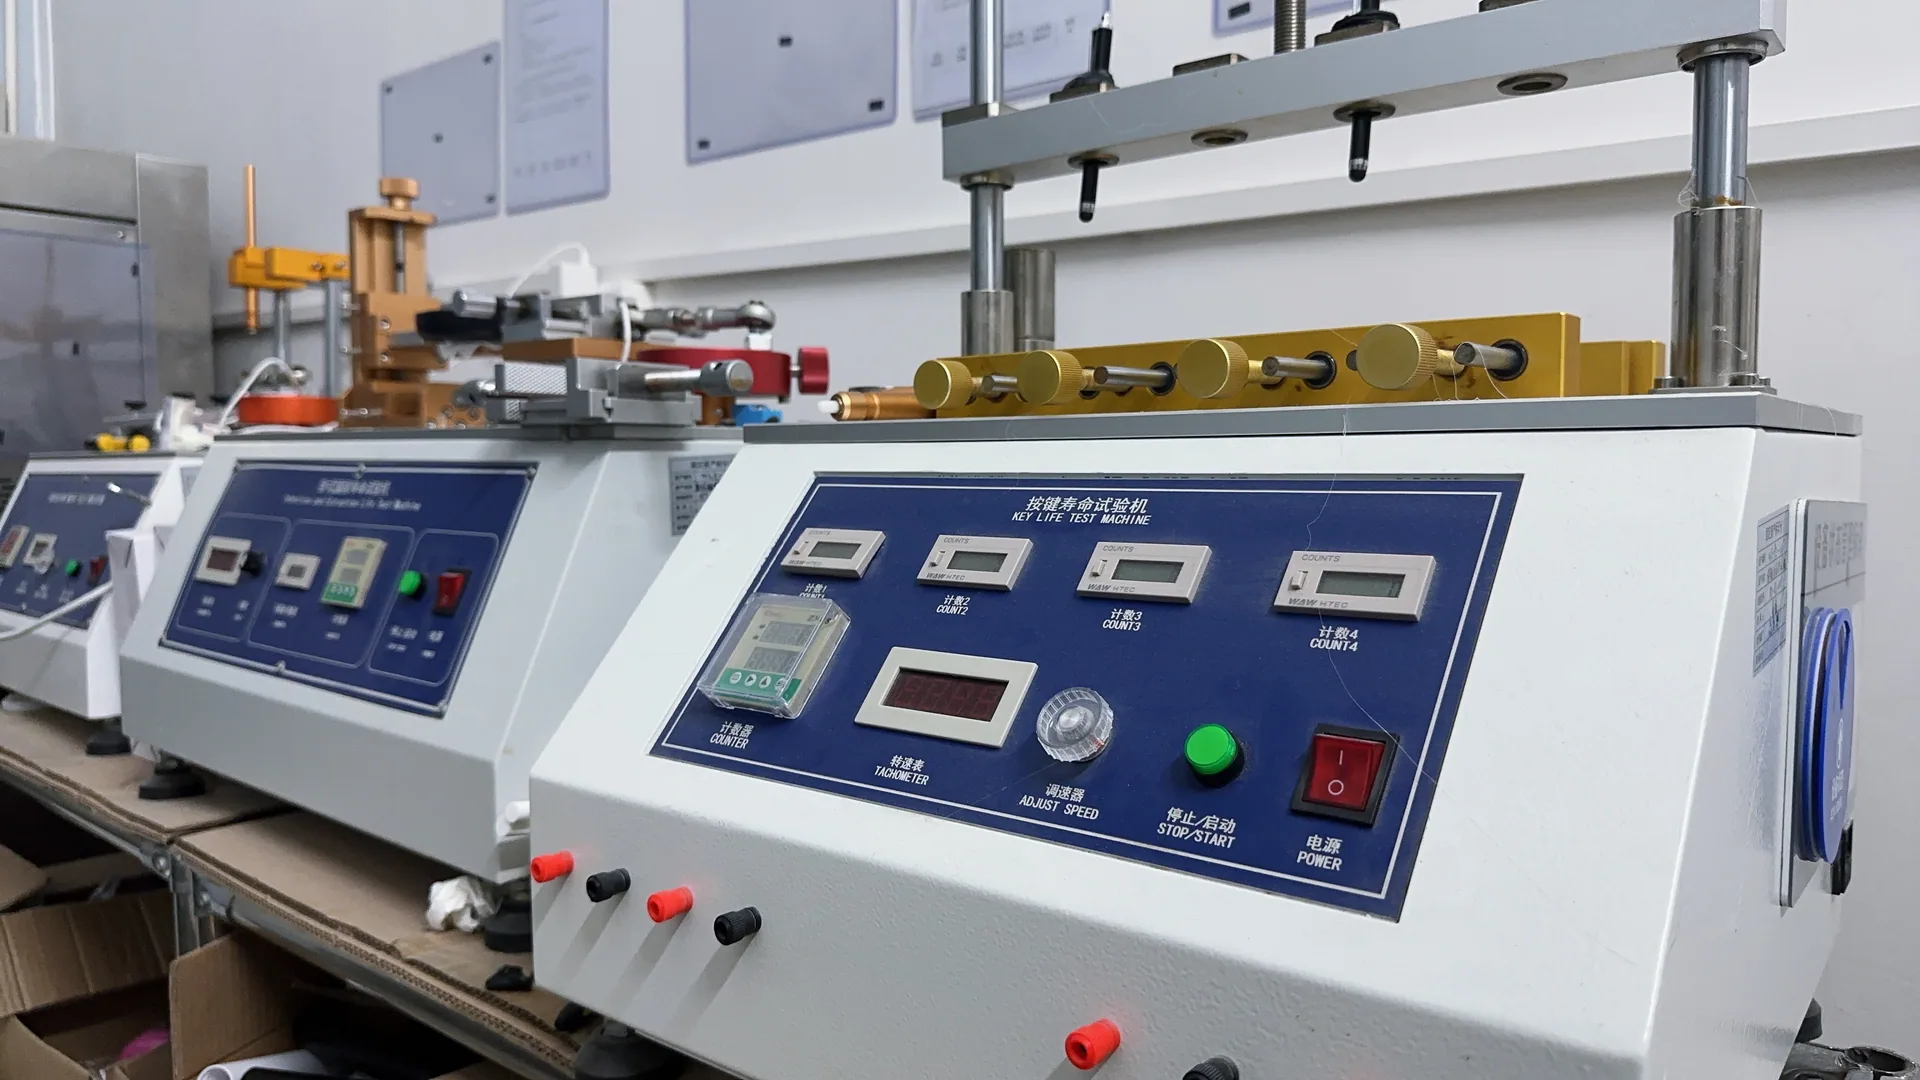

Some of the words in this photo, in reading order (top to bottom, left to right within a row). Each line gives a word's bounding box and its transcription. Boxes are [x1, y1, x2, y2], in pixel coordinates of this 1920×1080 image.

[1025, 496, 1149, 513] 按键寿命试验机
[1011, 511, 1033, 522] KEY
[1036, 513, 1064, 523] LIFE
[1069, 513, 1097, 523] TEST
[1099, 514, 1152, 525] MACHINE
[1102, 545, 1134, 553] COUNTS
[1301, 553, 1341, 563] COUNTS
[1112, 585, 1136, 593] HTEC
[943, 594, 971, 606] 计数2
[1319, 600, 1349, 609] HTEC
[936, 604, 969, 615] COUNT2
[1110, 608, 1143, 621] 计数3
[1102, 619, 1142, 632] COUNT3
[1318, 625, 1359, 640] 计数4
[1309, 638, 1359, 652] COUNT4
[720, 721, 755, 738] 计数器
[709, 732, 749, 750] COUNTER
[889, 754, 925, 772] 转速表
[874, 765, 930, 786] TACHOMETER
[1045, 783, 1086, 803] 调速器
[1018, 794, 1061, 813] ADJUST
[1063, 803, 1100, 820] SPEED
[1166, 806, 1237, 834] 停止/启动
[1157, 822, 1236, 849] STOP/START
[1305, 833, 1344, 855] 电源
[1296, 850, 1344, 872] POWER
